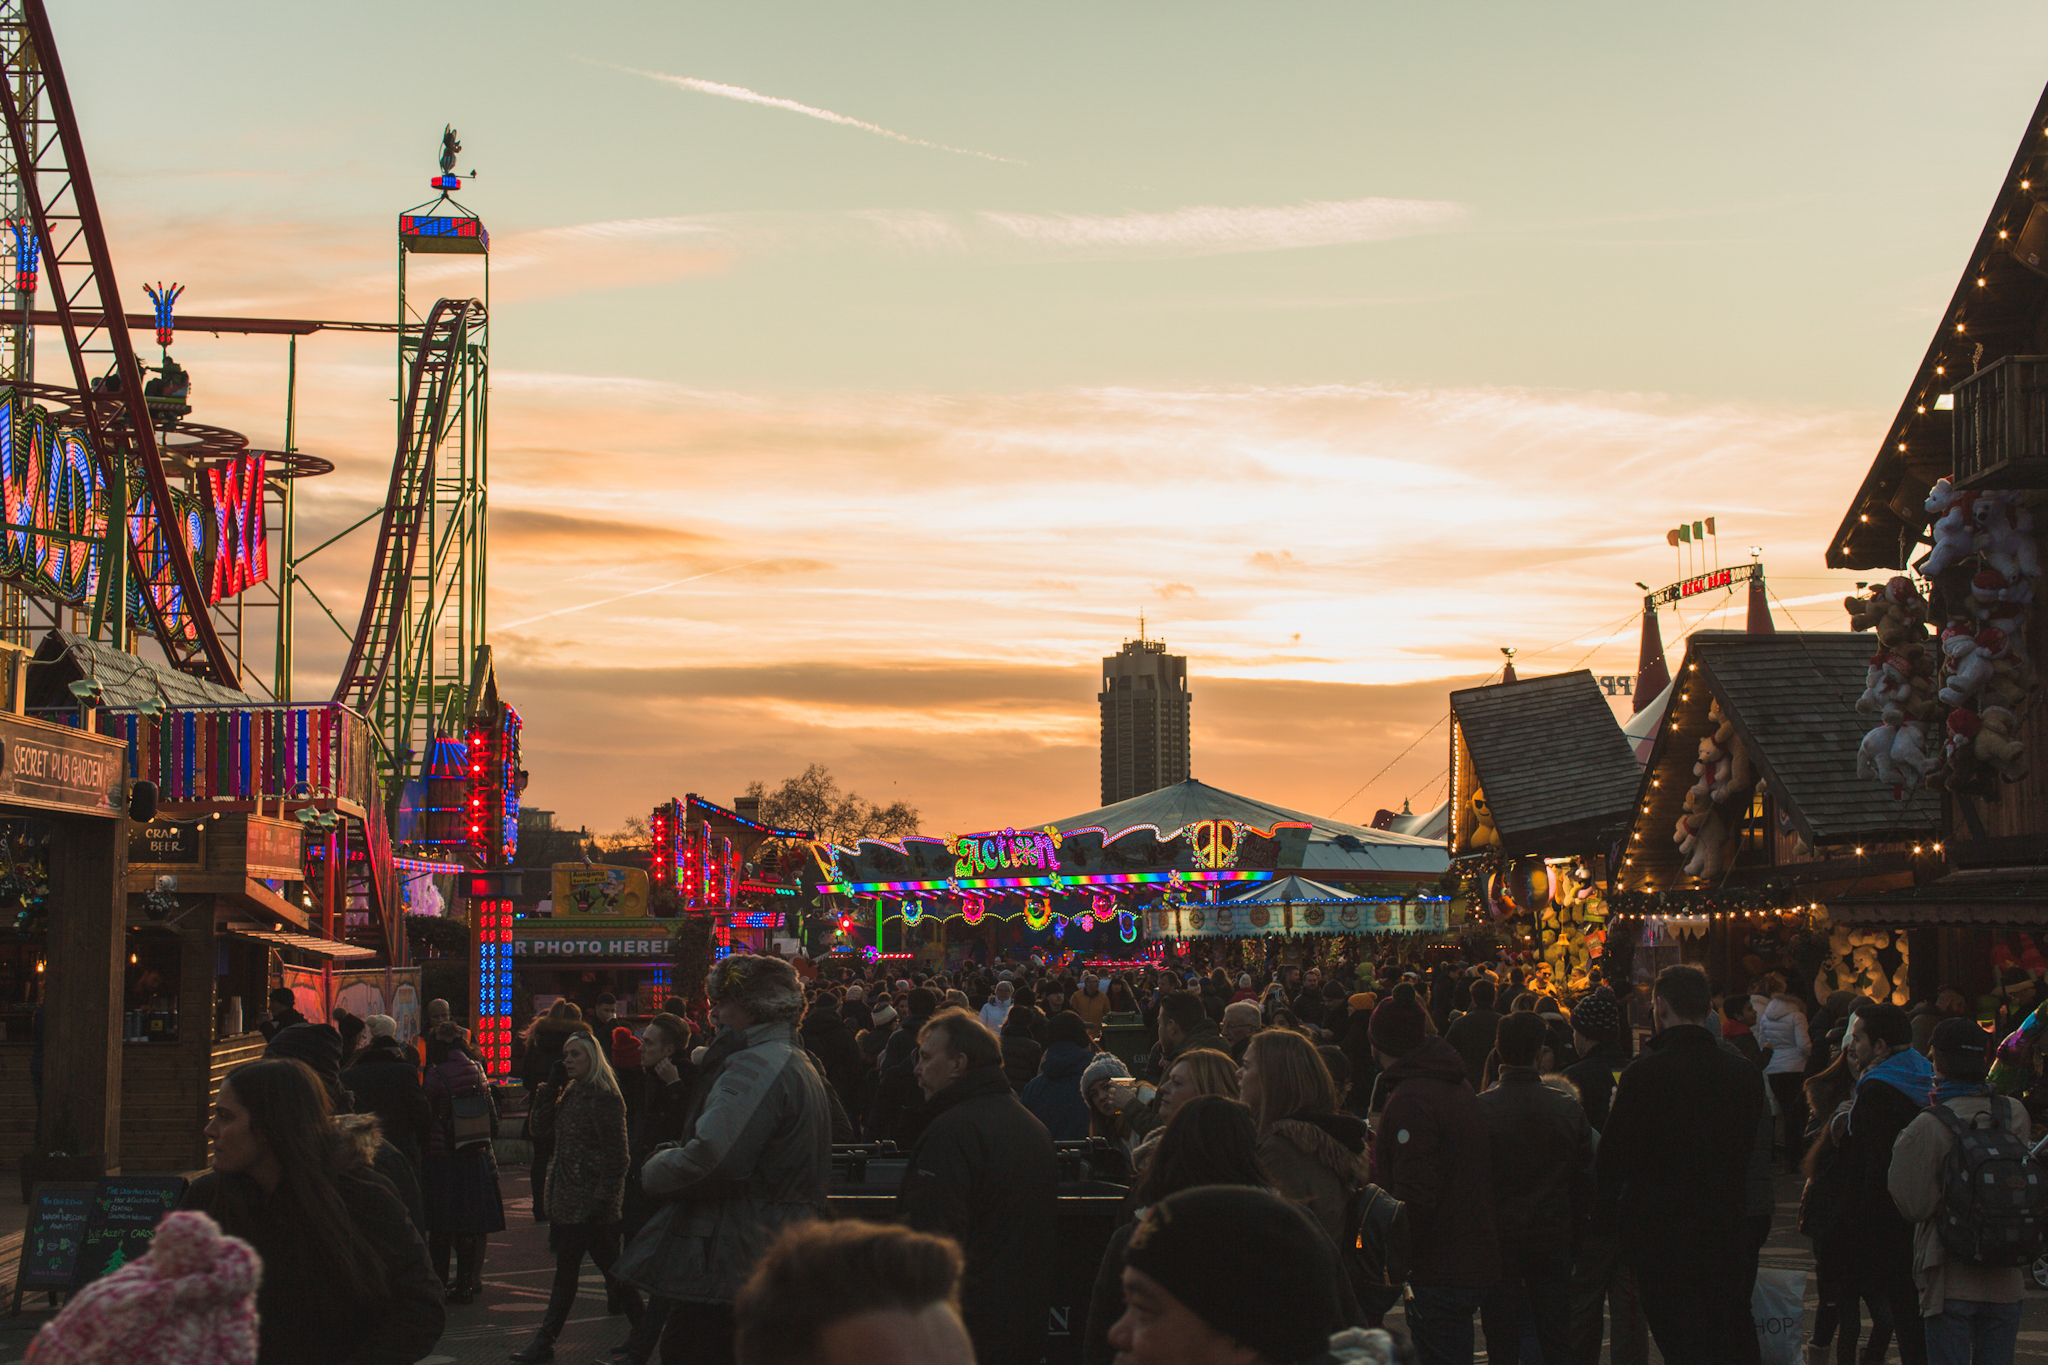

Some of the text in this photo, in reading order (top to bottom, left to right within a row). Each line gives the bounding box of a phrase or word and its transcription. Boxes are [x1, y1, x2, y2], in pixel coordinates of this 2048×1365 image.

[14, 745, 49, 778] SECRET
[51, 753, 70, 783] PUB
[71, 756, 104, 788] GARDEN
[150, 841, 186, 852] BEER
[954, 833, 1061, 877] Action
[572, 870, 605, 878] Ausgang
[534, 940, 602, 954] PHOTO
[609, 940, 669, 953] HERE!
[88, 1228, 102, 1239] WE
[102, 1228, 126, 1238] ACCEPT
